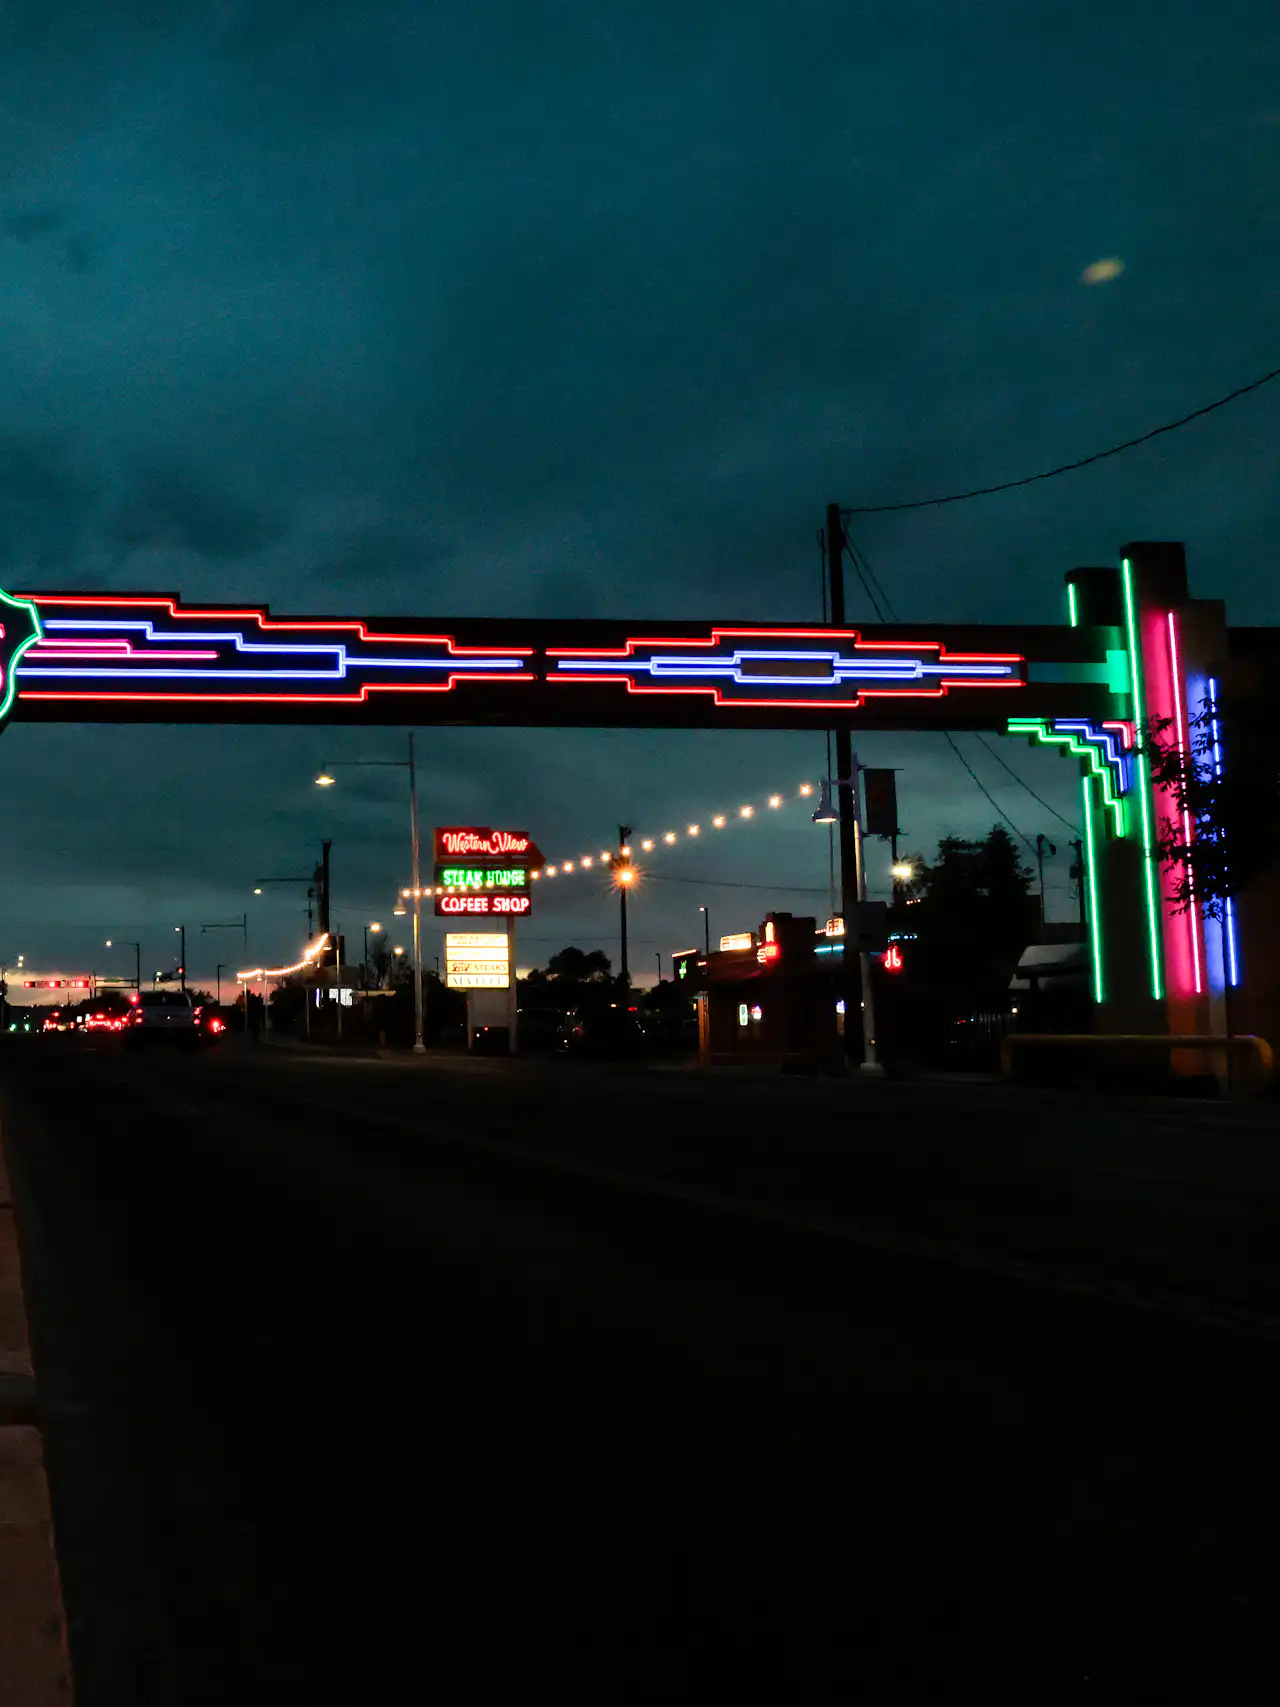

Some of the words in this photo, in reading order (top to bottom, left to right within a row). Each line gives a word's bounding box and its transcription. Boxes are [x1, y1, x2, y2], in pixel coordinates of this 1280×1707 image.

[442, 832, 499, 853] Western
[491, 832, 528, 852] View
[443, 869, 483, 886] STEAK
[441, 896, 488, 911] COFFEE
[492, 897, 530, 911] SHOP
[473, 964, 507, 972] STEAKS
